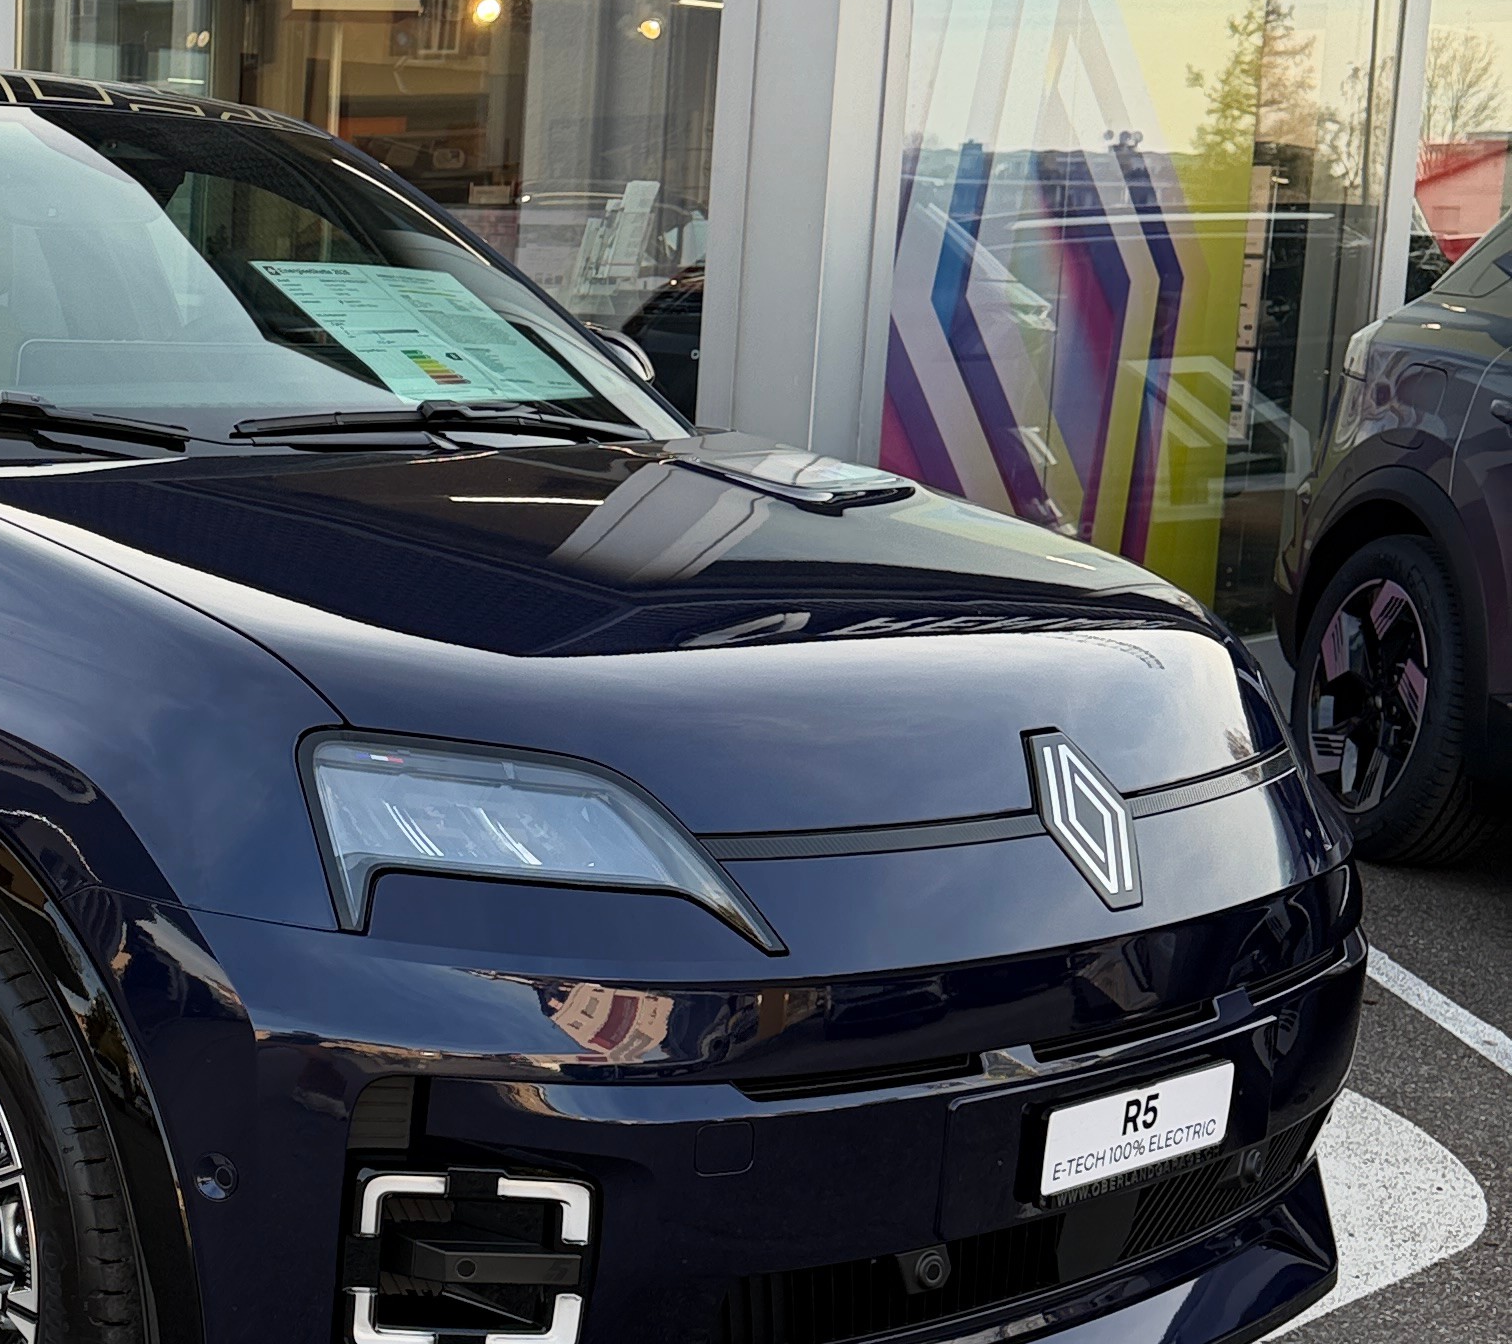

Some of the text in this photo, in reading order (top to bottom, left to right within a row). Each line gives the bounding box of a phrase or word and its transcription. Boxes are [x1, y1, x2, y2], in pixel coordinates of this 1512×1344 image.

[1121, 1093, 1160, 1137] R5
[1052, 1118, 1217, 1181] E-TECH 100% ELECTRIC
[1055, 1145, 1221, 1207] WWW.OBERLANDGARAGE.CH
